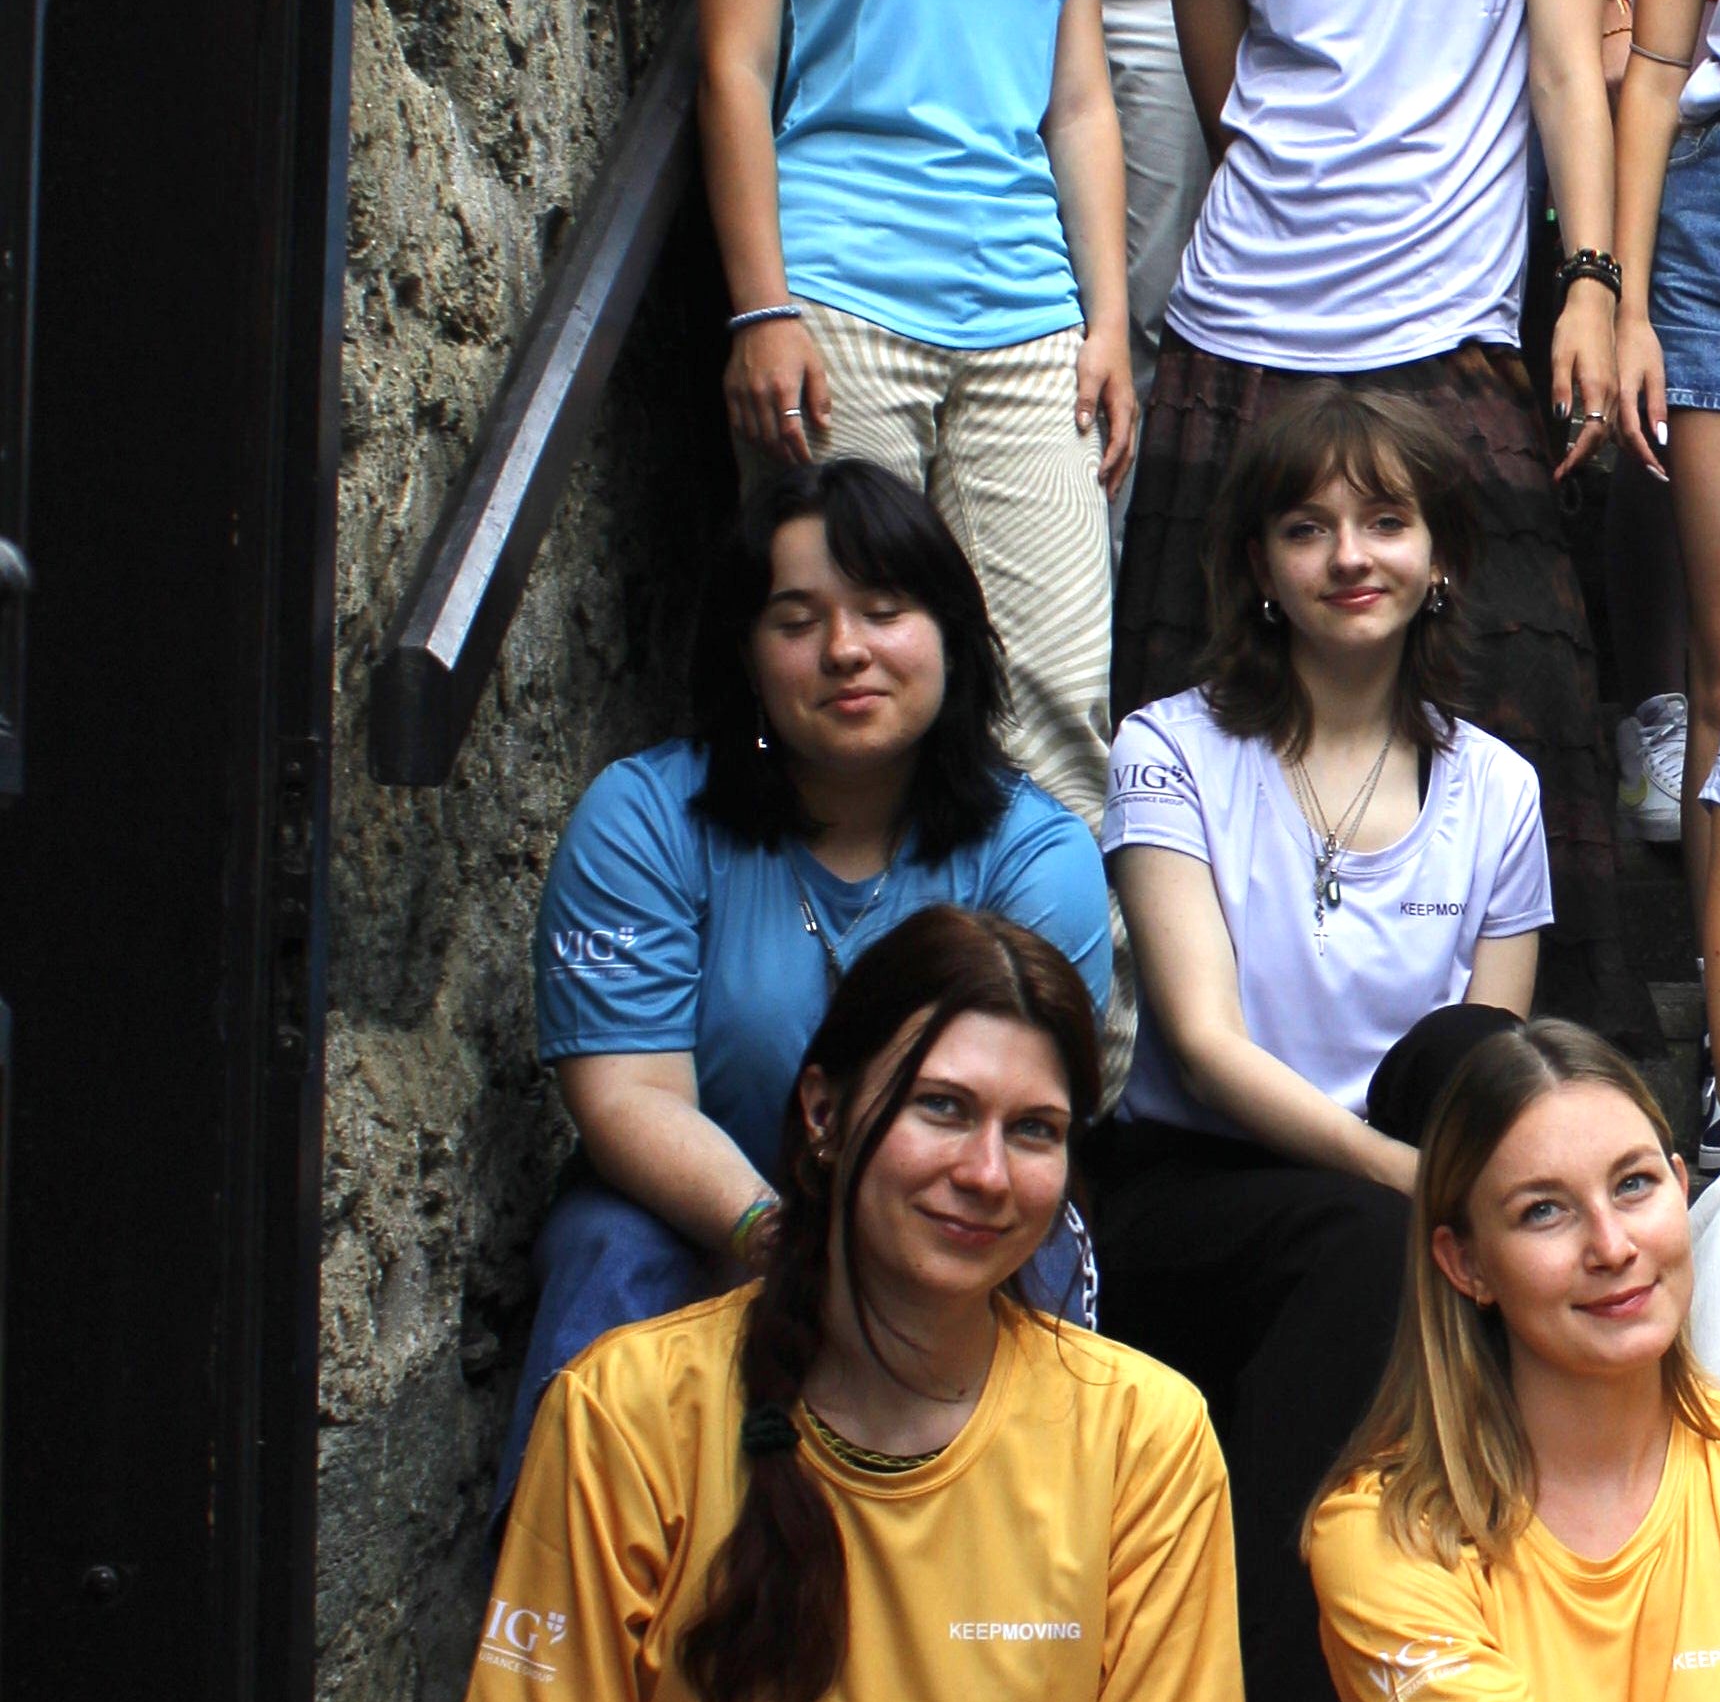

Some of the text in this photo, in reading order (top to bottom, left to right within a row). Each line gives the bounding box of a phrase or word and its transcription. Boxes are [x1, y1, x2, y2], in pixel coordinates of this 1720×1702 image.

[1114, 763, 1168, 790] VIG
[1400, 902, 1468, 917] KEEPMOV
[551, 929, 616, 962] VIG
[487, 1598, 542, 1653] IG
[949, 1622, 1082, 1641] KEEPMOVING
